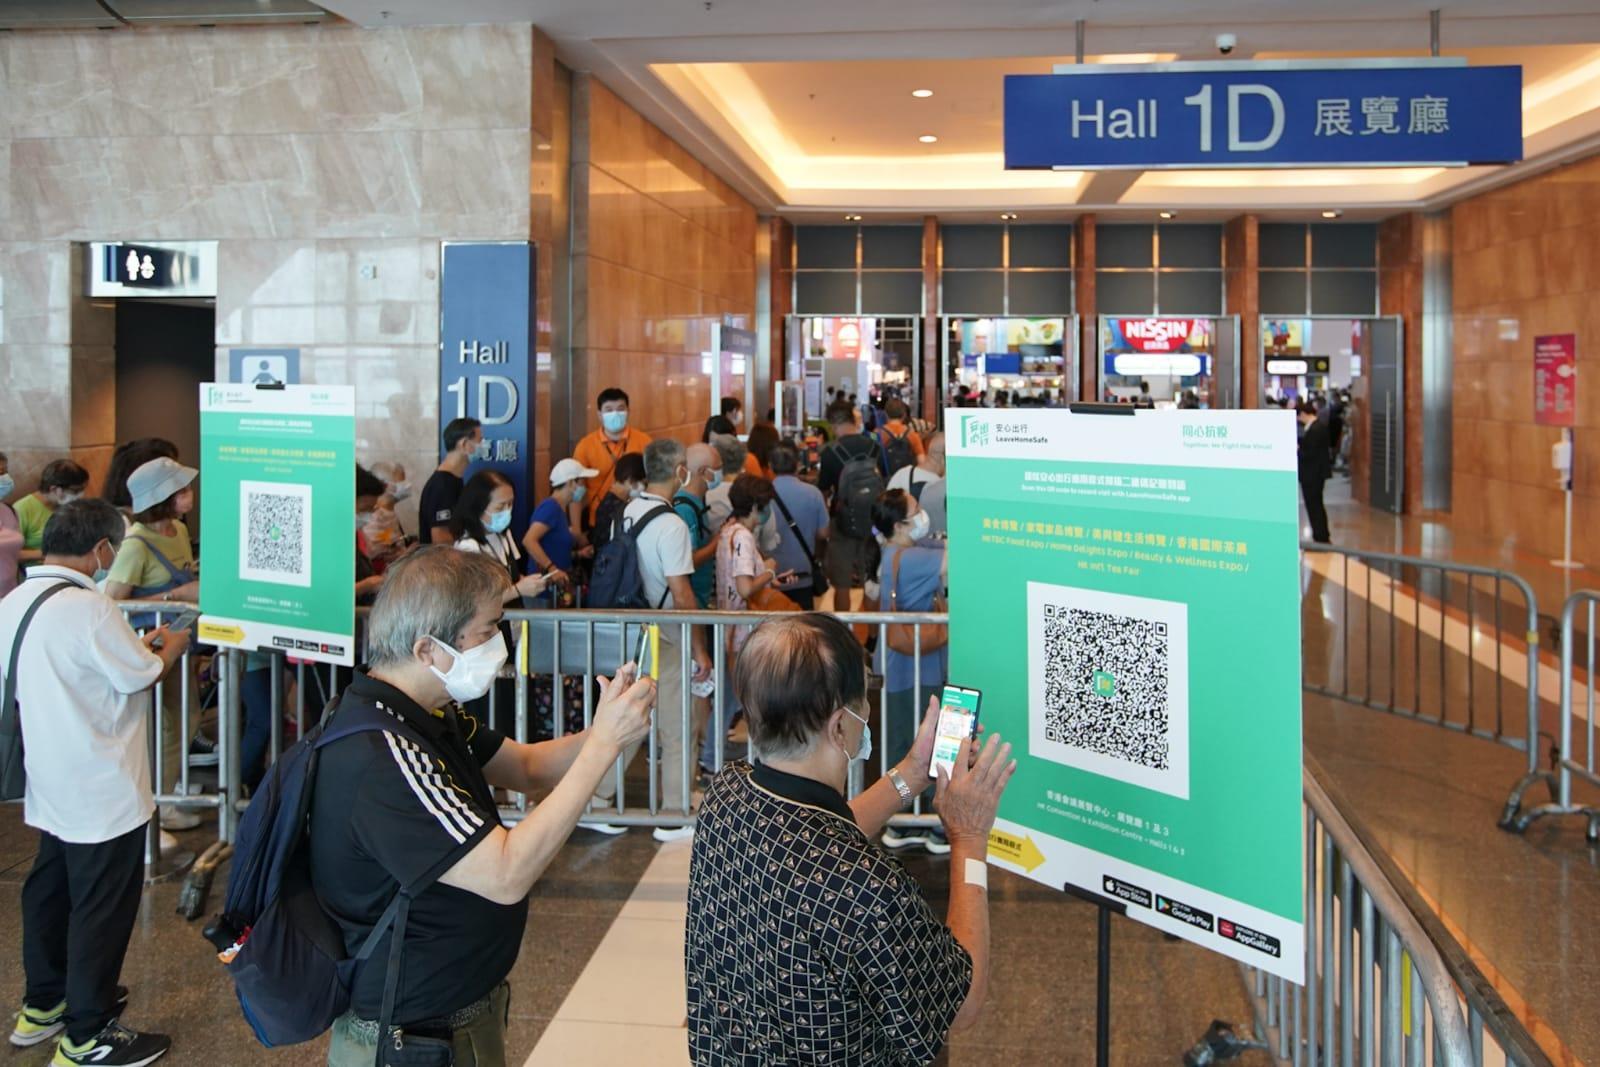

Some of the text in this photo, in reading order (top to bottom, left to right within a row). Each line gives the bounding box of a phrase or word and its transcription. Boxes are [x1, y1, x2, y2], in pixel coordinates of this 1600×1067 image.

[1071, 83, 1450, 152] Hall 1D 展覽廳
[1125, 318, 1188, 342] NISSIN
[460, 340, 509, 364] Hall
[447, 375, 520, 425] 1D
[995, 435, 1048, 444] LeaveHomeSafe
[1219, 560, 1243, 572] Expo
[1115, 886, 1149, 905] App Store
[1171, 907, 1196, 922] Google
[1196, 915, 1211, 930] Play
[1235, 931, 1278, 955] AppGallery
